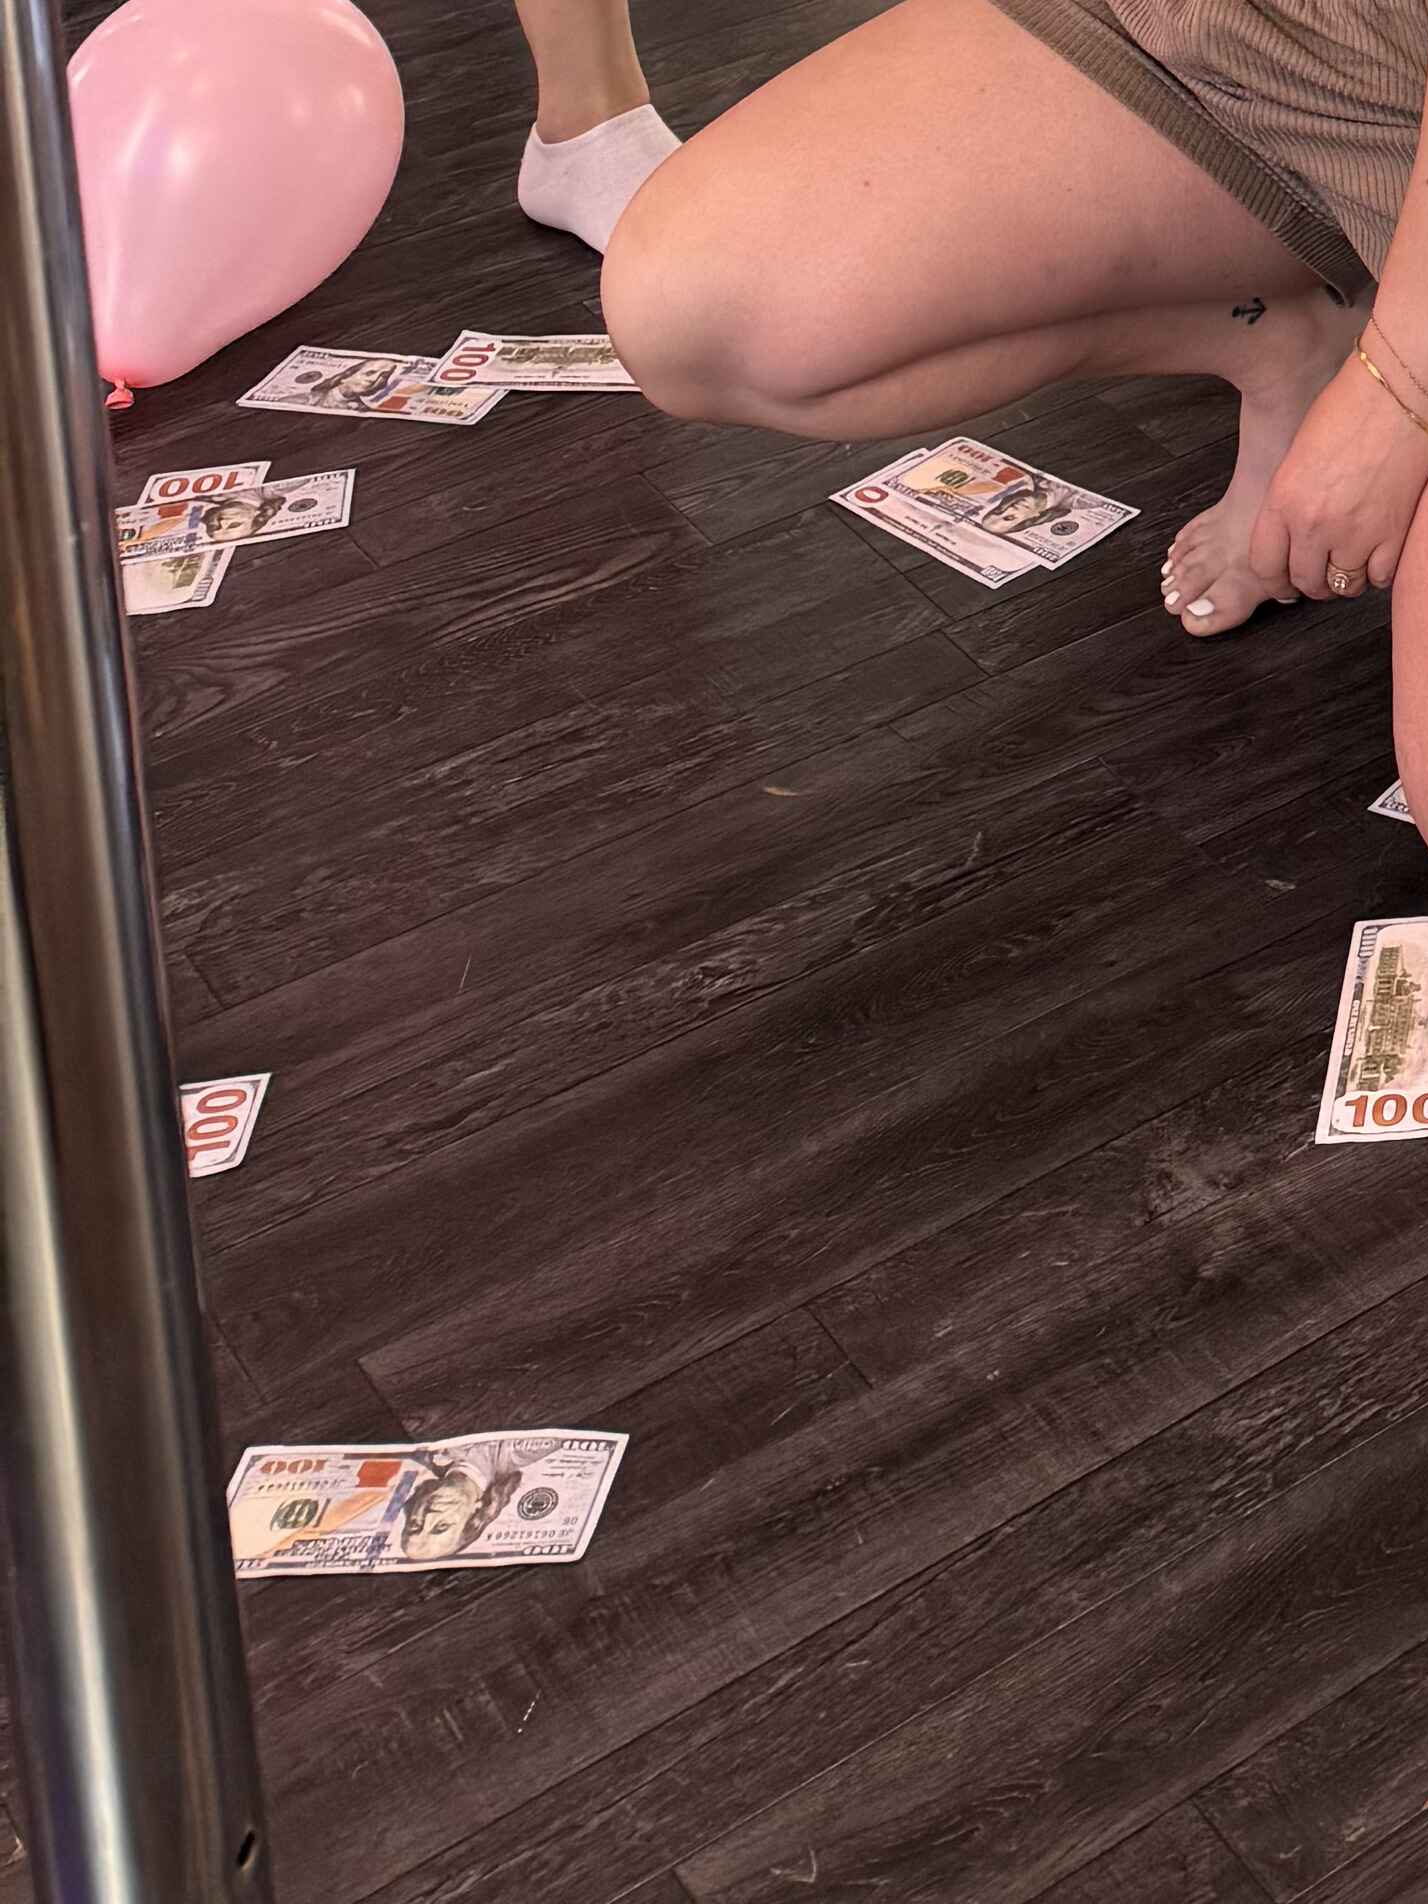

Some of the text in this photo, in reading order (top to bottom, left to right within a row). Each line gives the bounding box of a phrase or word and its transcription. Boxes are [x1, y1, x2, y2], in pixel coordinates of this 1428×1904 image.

[440, 343, 497, 382] 100
[158, 470, 243, 498] 100
[186, 1089, 247, 1161] 100
[261, 1460, 325, 1474] 100
